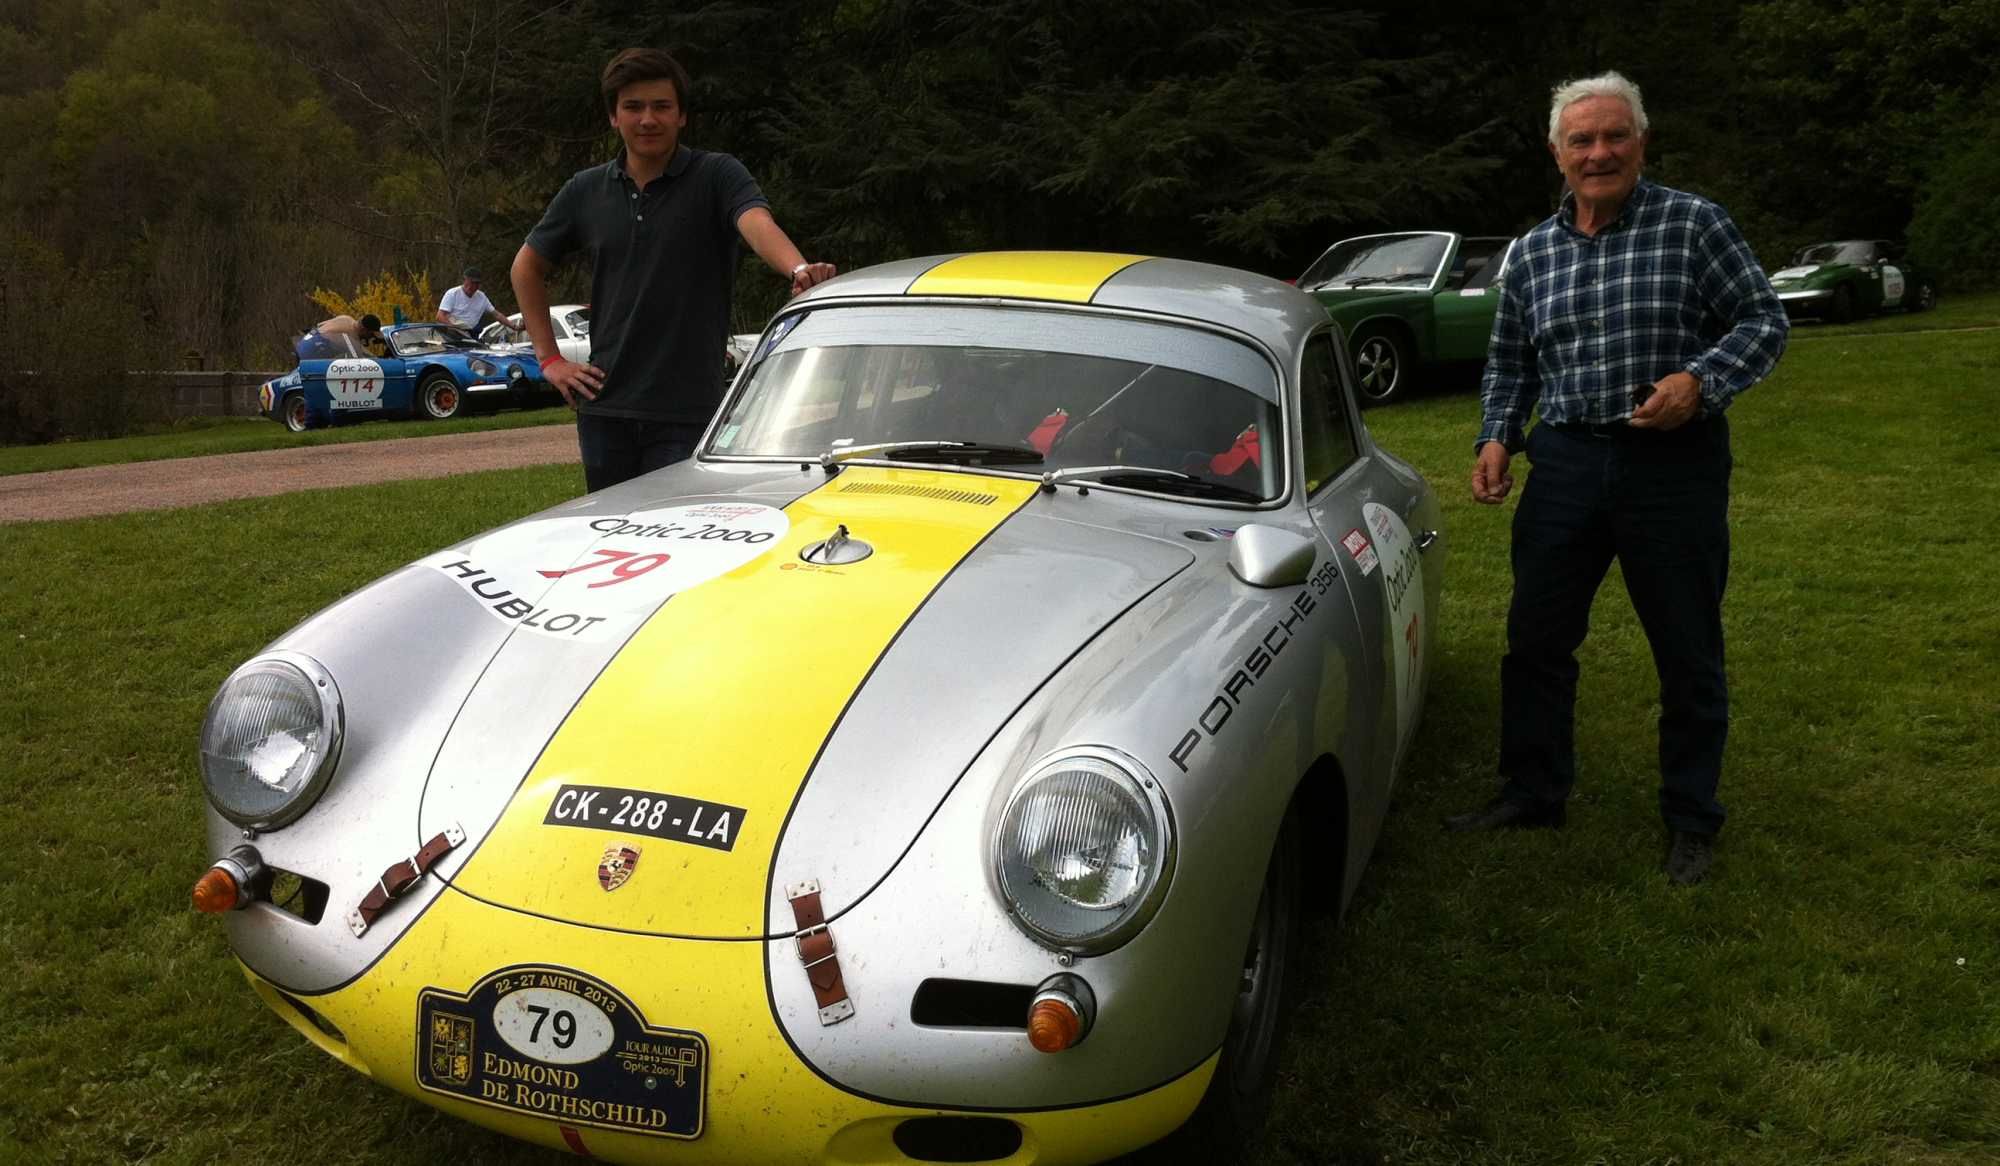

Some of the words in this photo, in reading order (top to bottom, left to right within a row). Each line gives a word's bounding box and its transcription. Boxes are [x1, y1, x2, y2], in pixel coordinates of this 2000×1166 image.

[331, 365, 356, 375] Optic
[340, 378, 374, 393] 114
[338, 400, 375, 408] HUBLOT
[589, 518, 685, 538] Optic
[679, 524, 775, 544] 2000
[536, 549, 672, 589] 79
[442, 560, 606, 635] HUBLOT
[1168, 591, 1318, 773] PORSCHE
[1310, 561, 1339, 597] 356
[539, 975, 581, 994] AVRIL
[583, 986, 617, 1013] 2013
[527, 1004, 577, 1049] 79
[623, 1060, 650, 1075] Optic
[625, 1040, 650, 1054] TOUR
[651, 1044, 677, 1057] AUTO
[483, 1052, 579, 1090] EDMOND
[482, 1079, 509, 1101] DE
[515, 1083, 667, 1128] ROTHSCHILD
